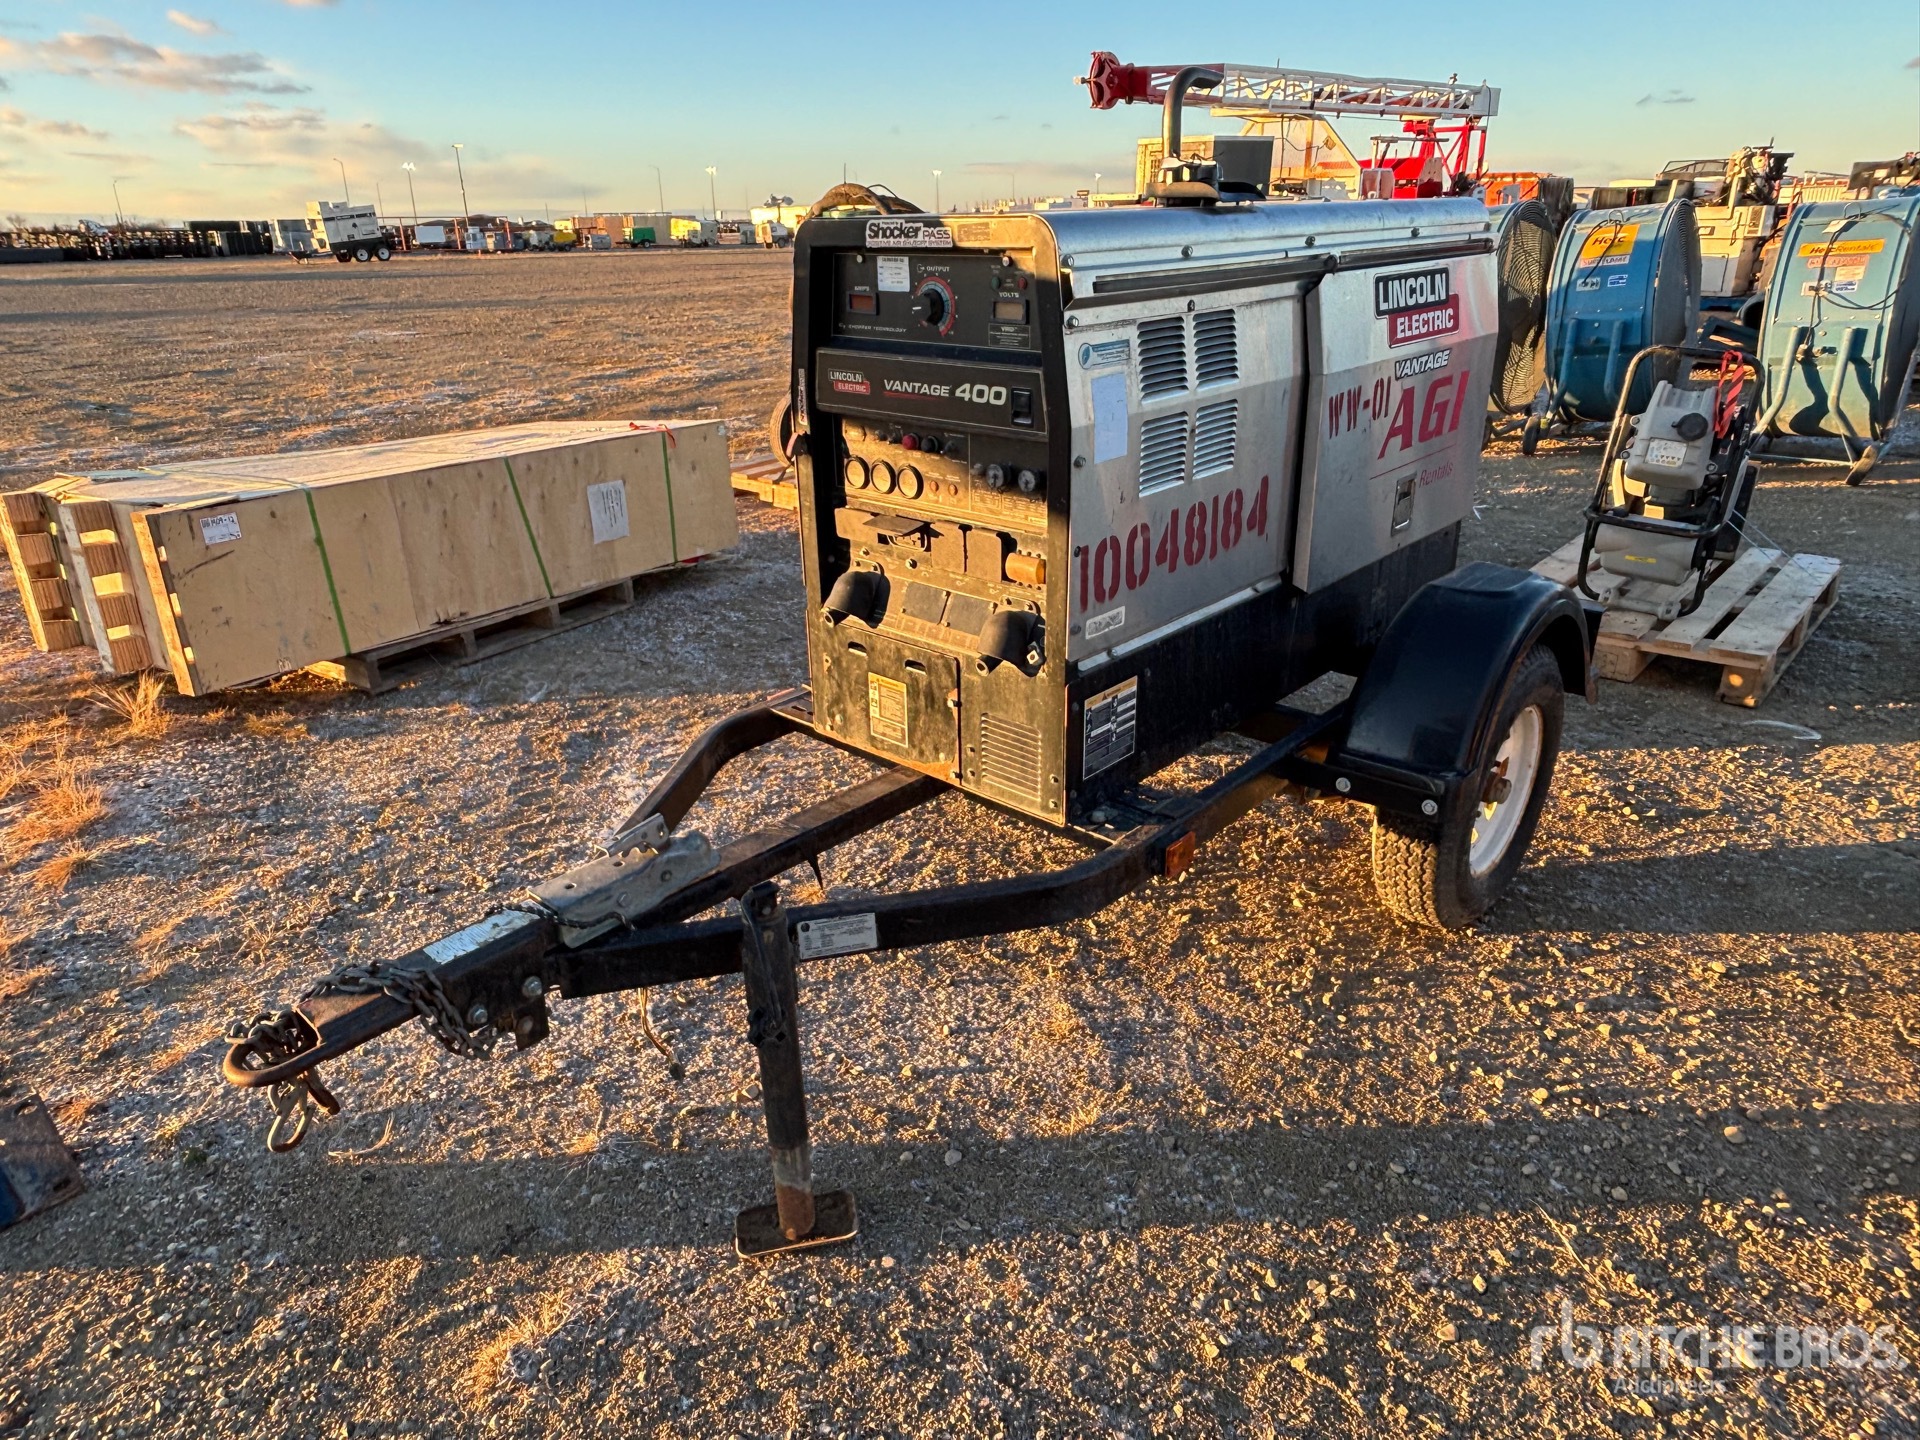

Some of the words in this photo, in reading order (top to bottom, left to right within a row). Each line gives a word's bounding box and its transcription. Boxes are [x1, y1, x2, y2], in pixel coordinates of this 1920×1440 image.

[868, 222, 921, 239] Shocker
[922, 229, 951, 239] PASS
[1378, 273, 1447, 311] LINCOLN
[1396, 308, 1454, 339] ELECTRIC
[829, 371, 863, 383] LINCOLN
[1394, 350, 1451, 380] VANTAGE
[837, 382, 867, 393] ELECTRIC
[883, 379, 950, 397] VANTAGE
[955, 383, 1007, 405] 400
[1377, 370, 1470, 460] AGI
[1419, 460, 1454, 488] Rentals
[1080, 475, 1269, 612] 10048184
